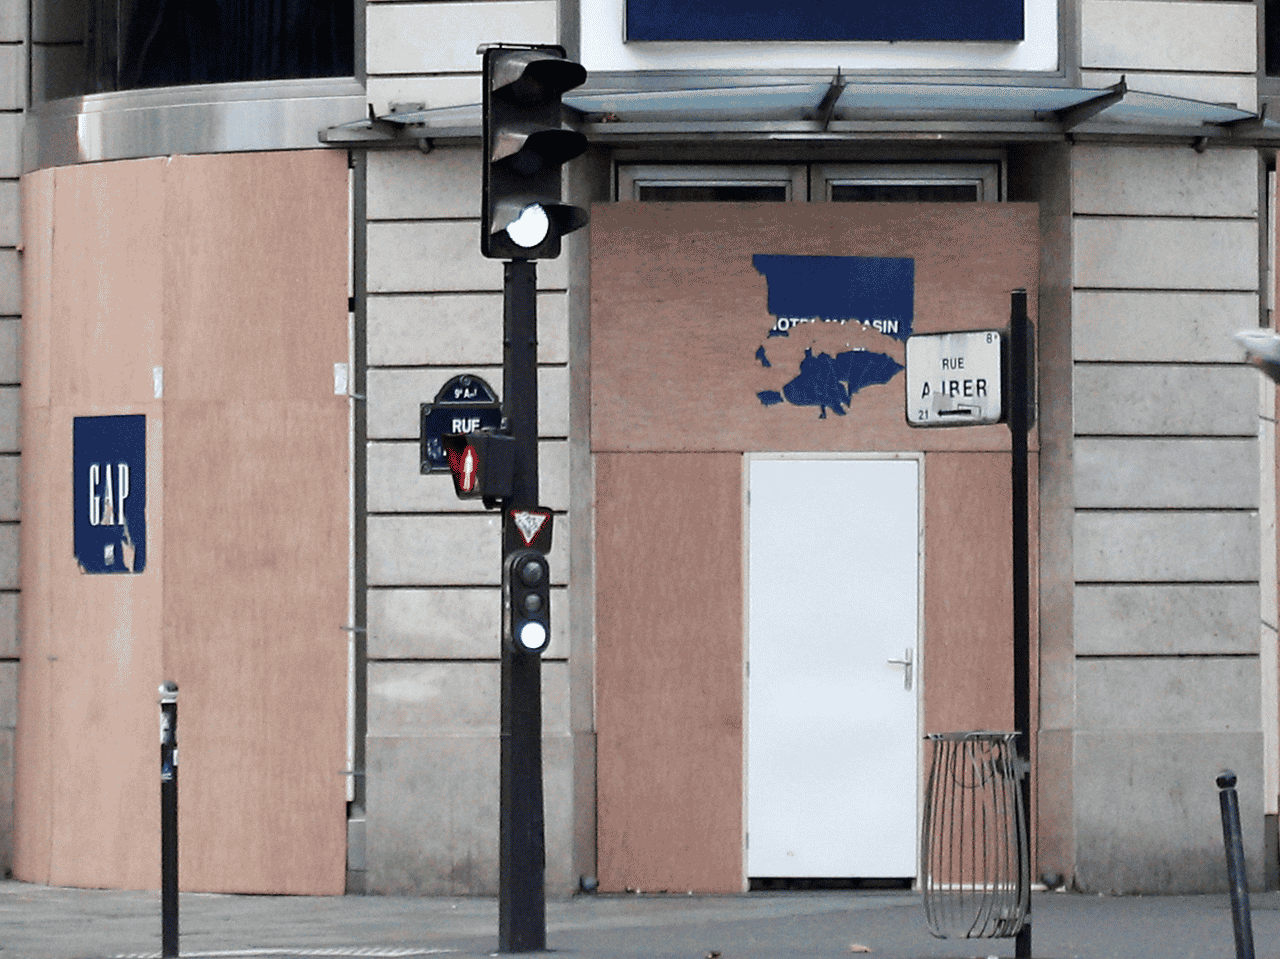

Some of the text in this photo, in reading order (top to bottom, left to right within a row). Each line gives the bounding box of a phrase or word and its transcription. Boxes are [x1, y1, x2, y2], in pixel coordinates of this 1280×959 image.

[942, 357, 965, 370] RUE
[918, 409, 929, 420] 21
[89, 463, 130, 526] GAP
